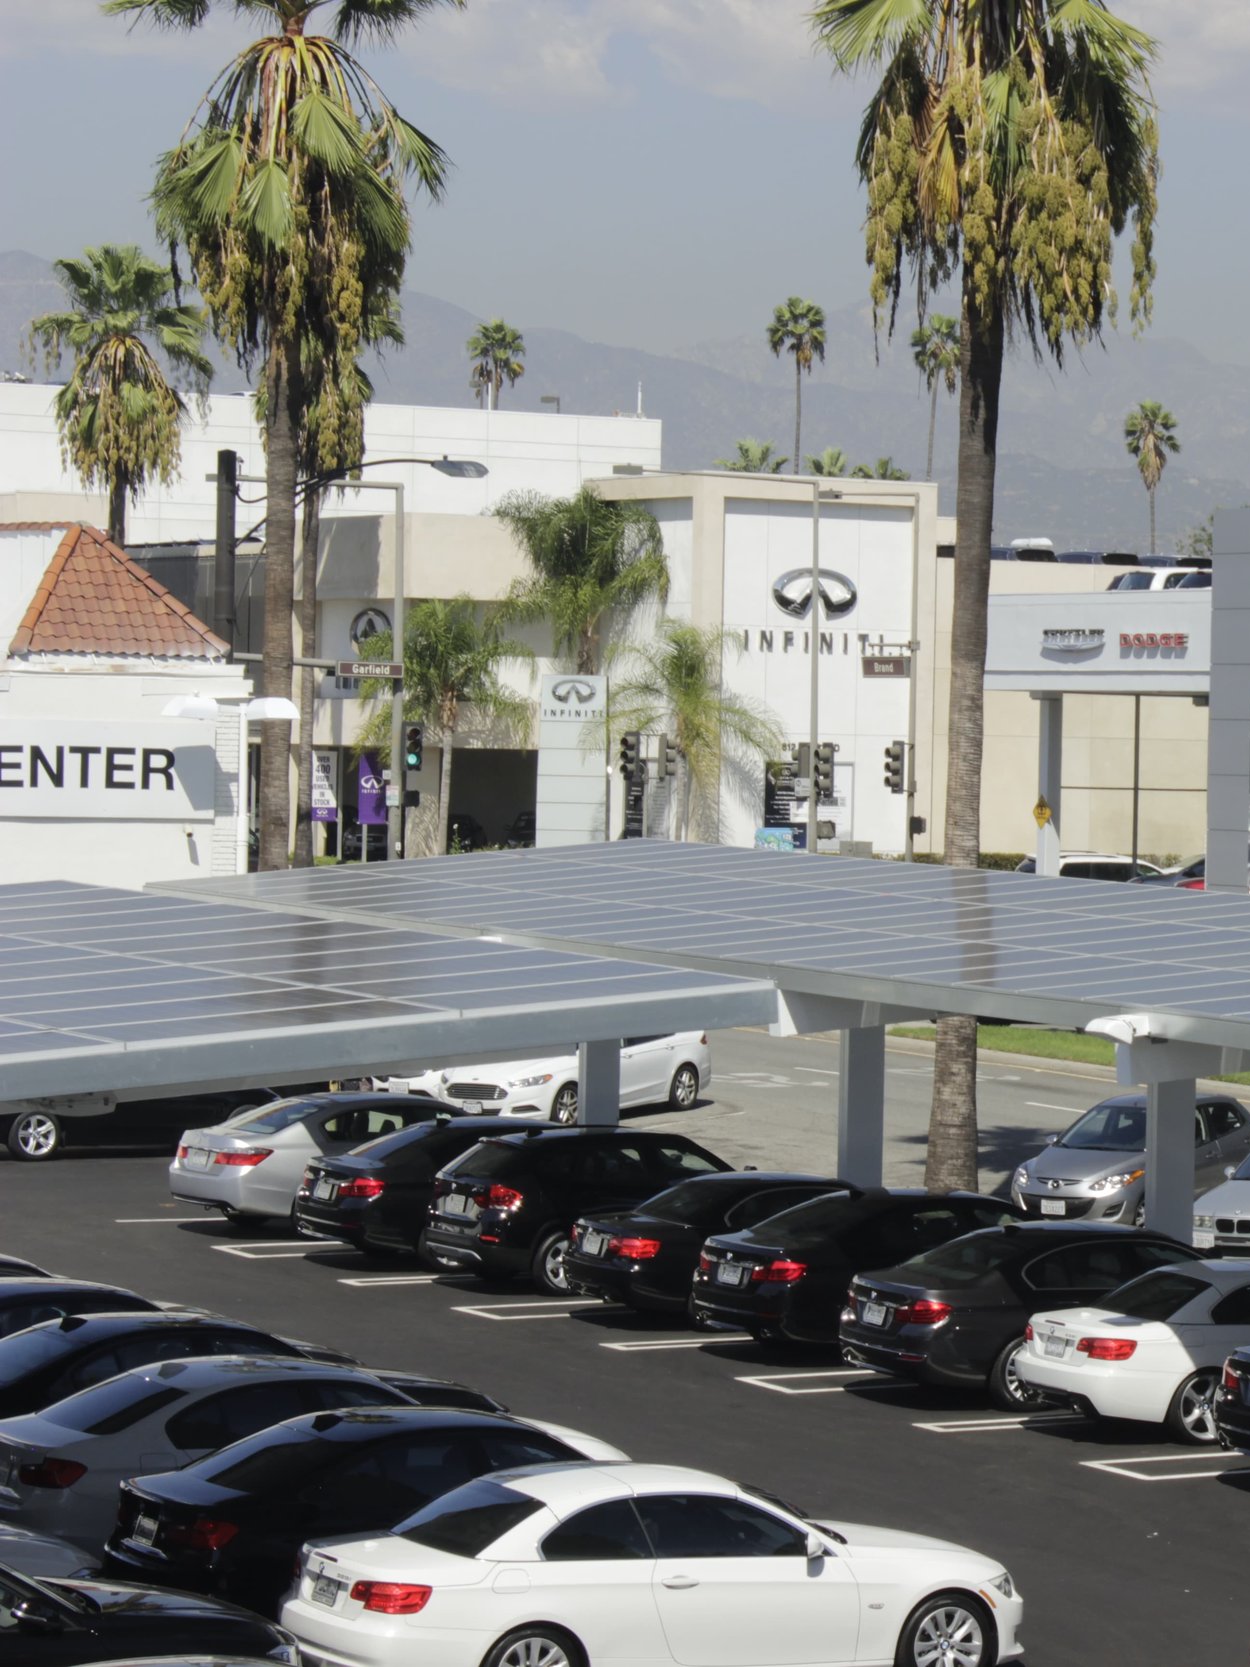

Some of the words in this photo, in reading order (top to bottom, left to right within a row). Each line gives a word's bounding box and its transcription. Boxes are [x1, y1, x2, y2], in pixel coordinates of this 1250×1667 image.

[743, 629, 884, 657] INFINITI
[1119, 633, 1186, 648] DODGE
[352, 664, 391, 675] Garfield
[873, 662, 894, 673] Brand
[543, 709, 604, 718] INFINITI
[0, 745, 175, 790] ENTER
